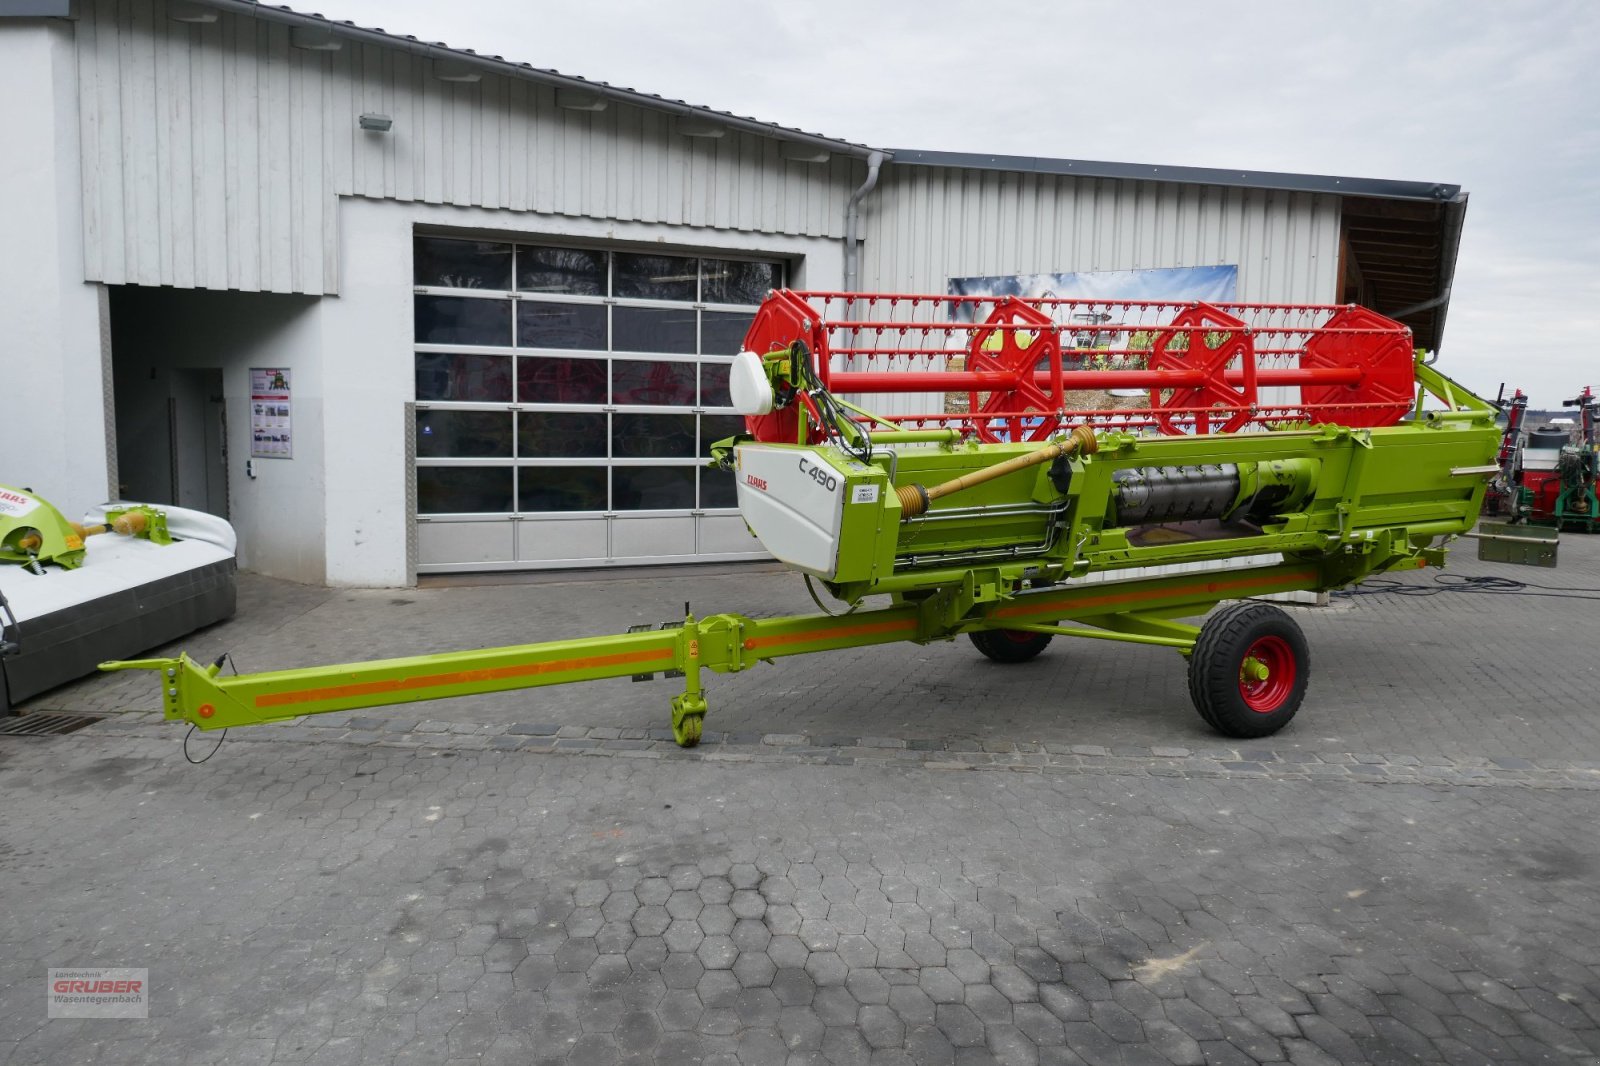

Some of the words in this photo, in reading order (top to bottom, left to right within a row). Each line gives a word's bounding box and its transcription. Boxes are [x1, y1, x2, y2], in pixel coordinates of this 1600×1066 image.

[747, 474, 768, 491] CLAAS
[798, 457, 808, 473] C
[808, 466, 837, 492] 490
[0, 491, 28, 504] AAS
